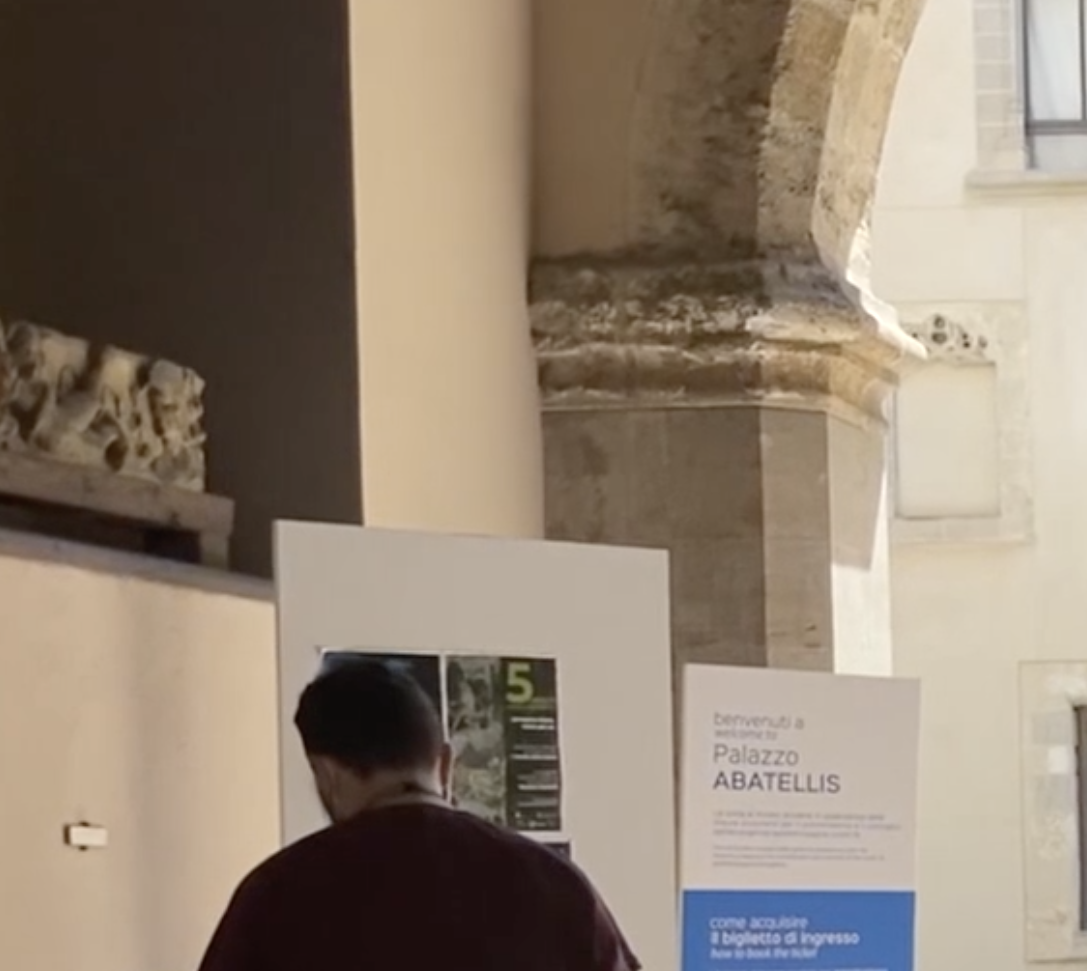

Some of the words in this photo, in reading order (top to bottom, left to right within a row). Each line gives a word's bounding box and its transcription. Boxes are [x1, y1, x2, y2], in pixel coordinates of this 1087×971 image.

[505, 663, 534, 704] 5
[713, 712, 792, 729] benvenuti
[794, 717, 805, 730] a
[713, 743, 800, 766] Palazzo
[712, 770, 841, 795] ABATELLIS
[709, 917, 746, 930] come
[749, 915, 809, 932] acquisire
[722, 930, 782, 948] biglietto
[784, 930, 798, 945] di
[801, 930, 860, 947] ingresso
